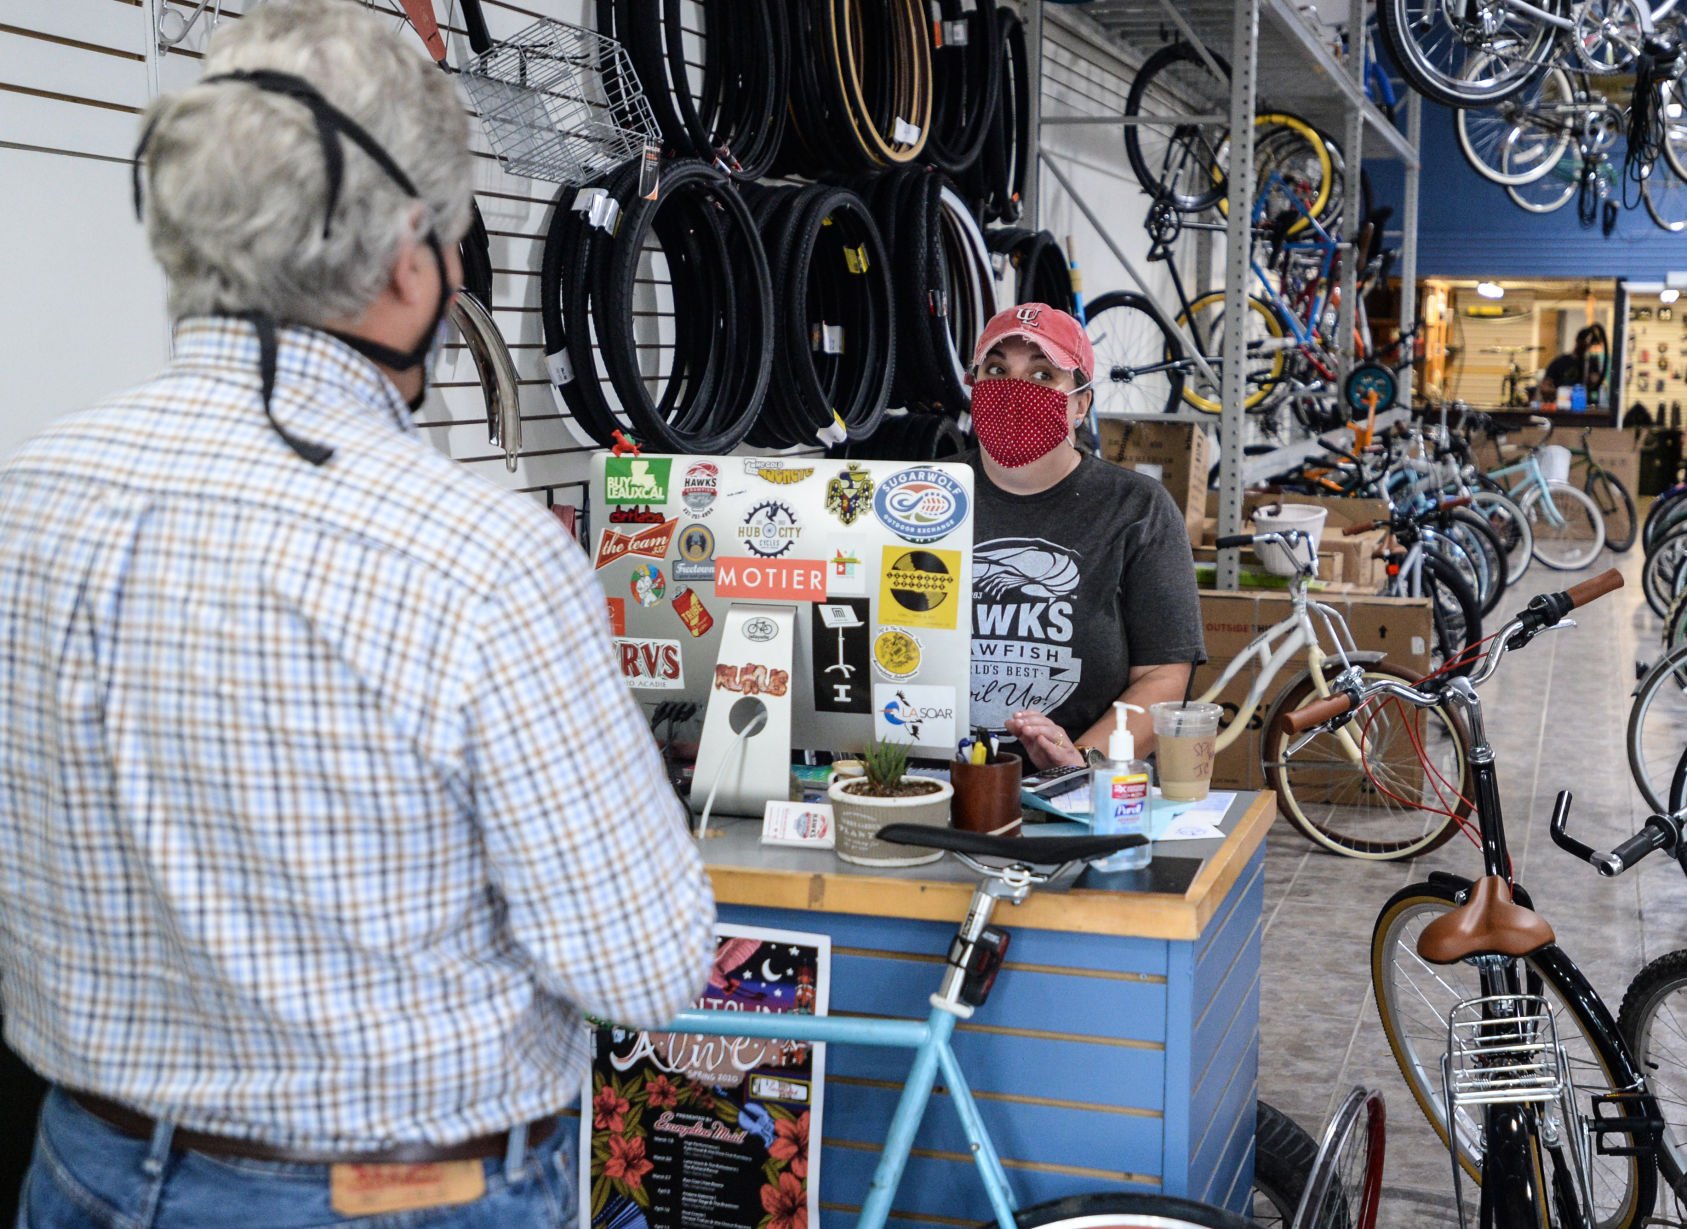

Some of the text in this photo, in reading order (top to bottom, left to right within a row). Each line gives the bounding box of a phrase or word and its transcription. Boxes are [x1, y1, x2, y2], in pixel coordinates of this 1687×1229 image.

[607, 476, 632, 489] BUY
[882, 471, 962, 495] SUGARWOLF
[607, 486, 665, 500] LEAUXCAL
[883, 514, 955, 534] OUTDOOR EXCHANGE
[738, 526, 802, 538] HUB CITY
[602, 526, 667, 555] the team
[717, 565, 823, 591] MOTIER
[1206, 623, 1249, 633] OUTSIDE
[971, 664, 1039, 678] LD'S BEST
[902, 707, 953, 719] LA SOAR
[610, 1030, 767, 1072] Alive
[686, 1069, 715, 1081] SPRING
[653, 1110, 748, 1145] Evangeline Maid
